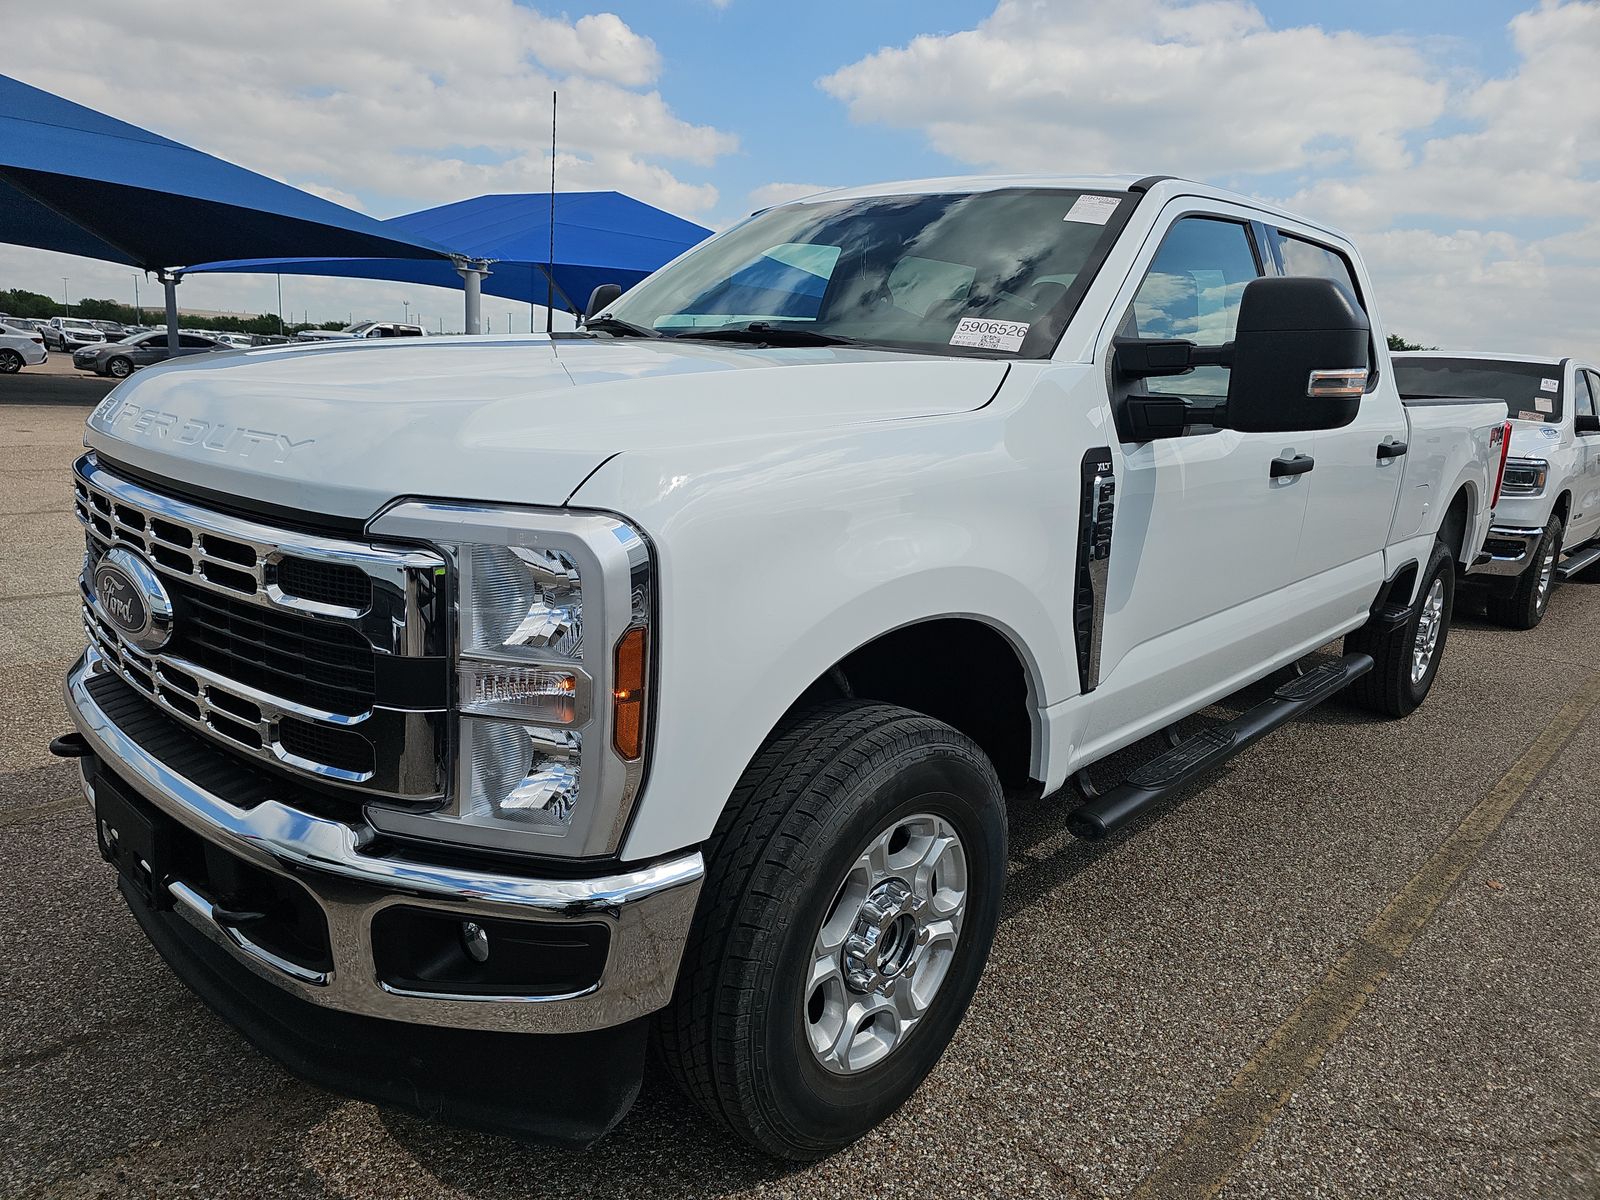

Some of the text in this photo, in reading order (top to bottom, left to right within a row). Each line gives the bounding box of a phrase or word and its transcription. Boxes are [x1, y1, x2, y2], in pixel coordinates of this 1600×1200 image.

[960, 321, 1028, 337] 5906526
[1097, 462, 1111, 471] XLT
[102, 575, 133, 624] Ford
